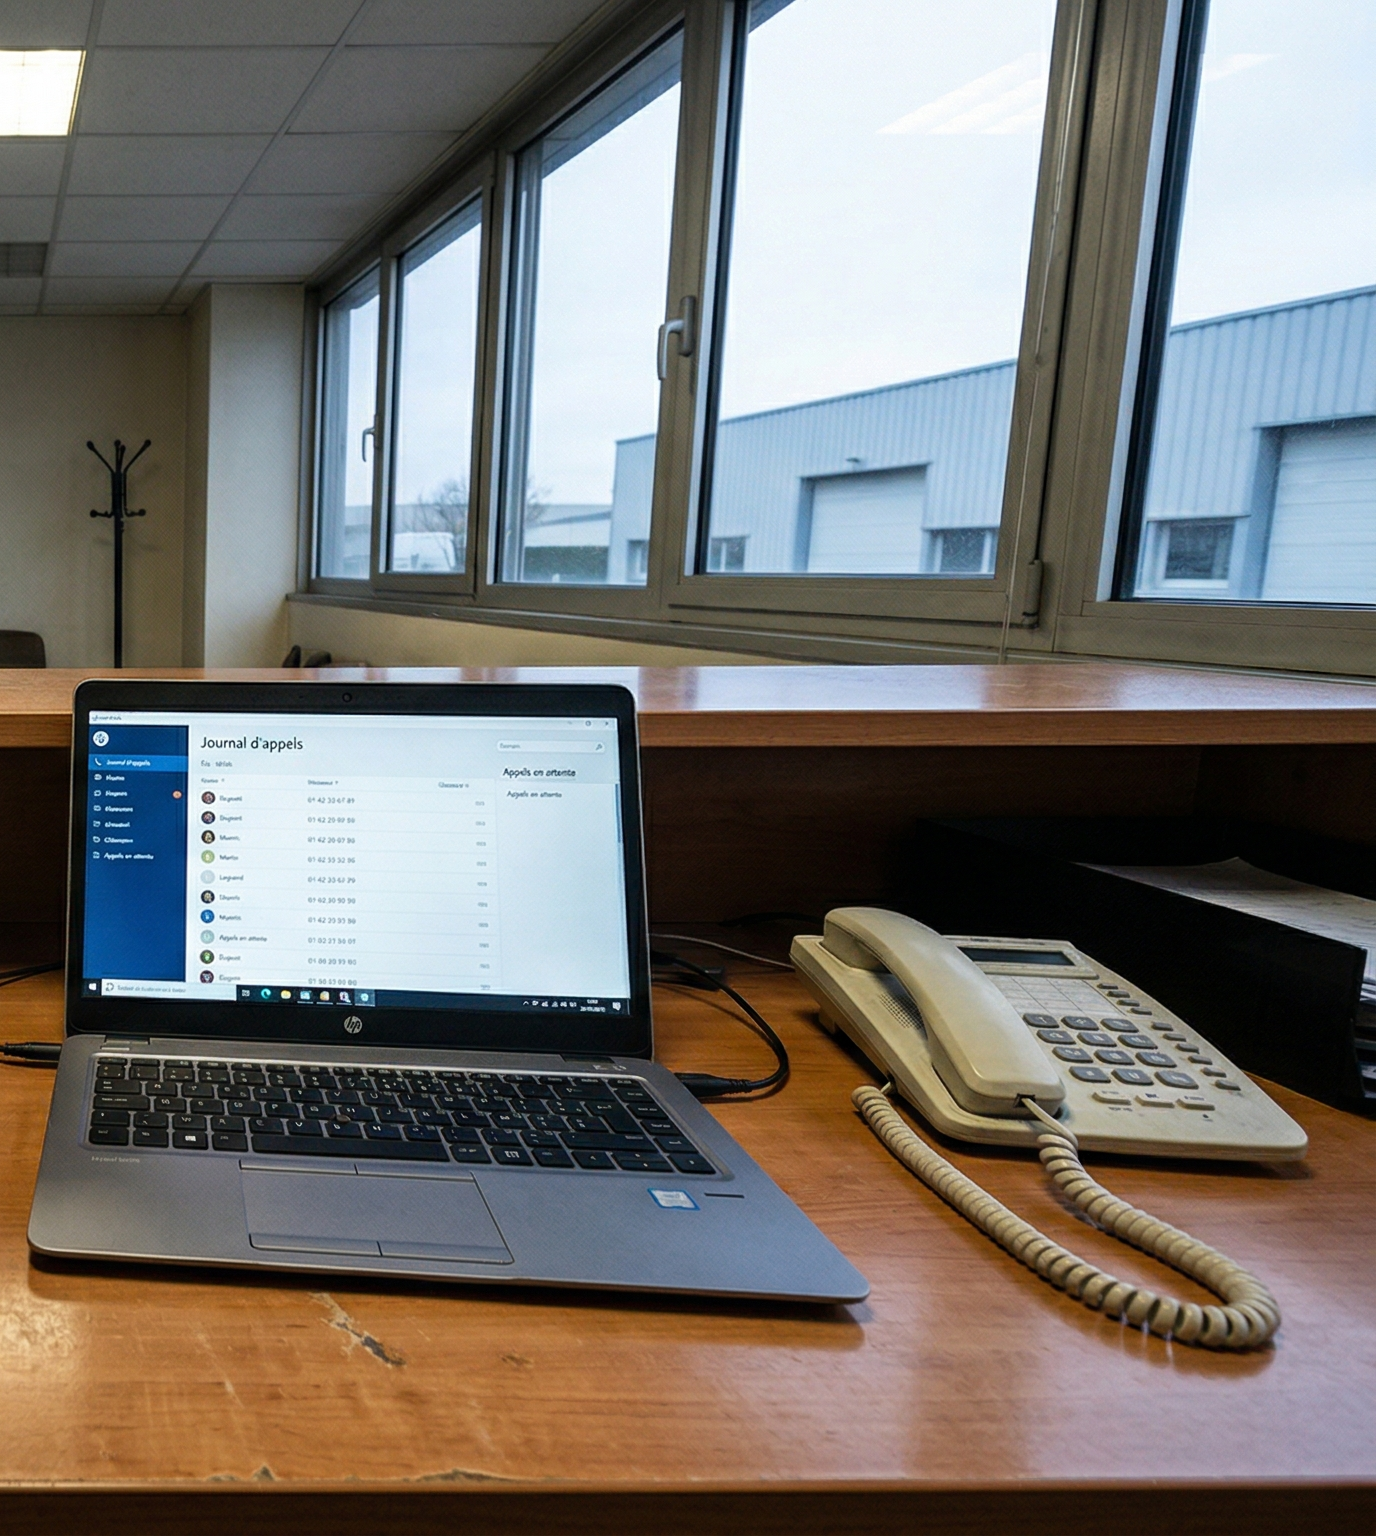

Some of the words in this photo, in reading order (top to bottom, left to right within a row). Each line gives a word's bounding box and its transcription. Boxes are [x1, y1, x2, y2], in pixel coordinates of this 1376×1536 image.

[200, 736, 247, 749] Journal
[250, 736, 303, 753] d'appels
[344, 1016, 363, 1034] hp
